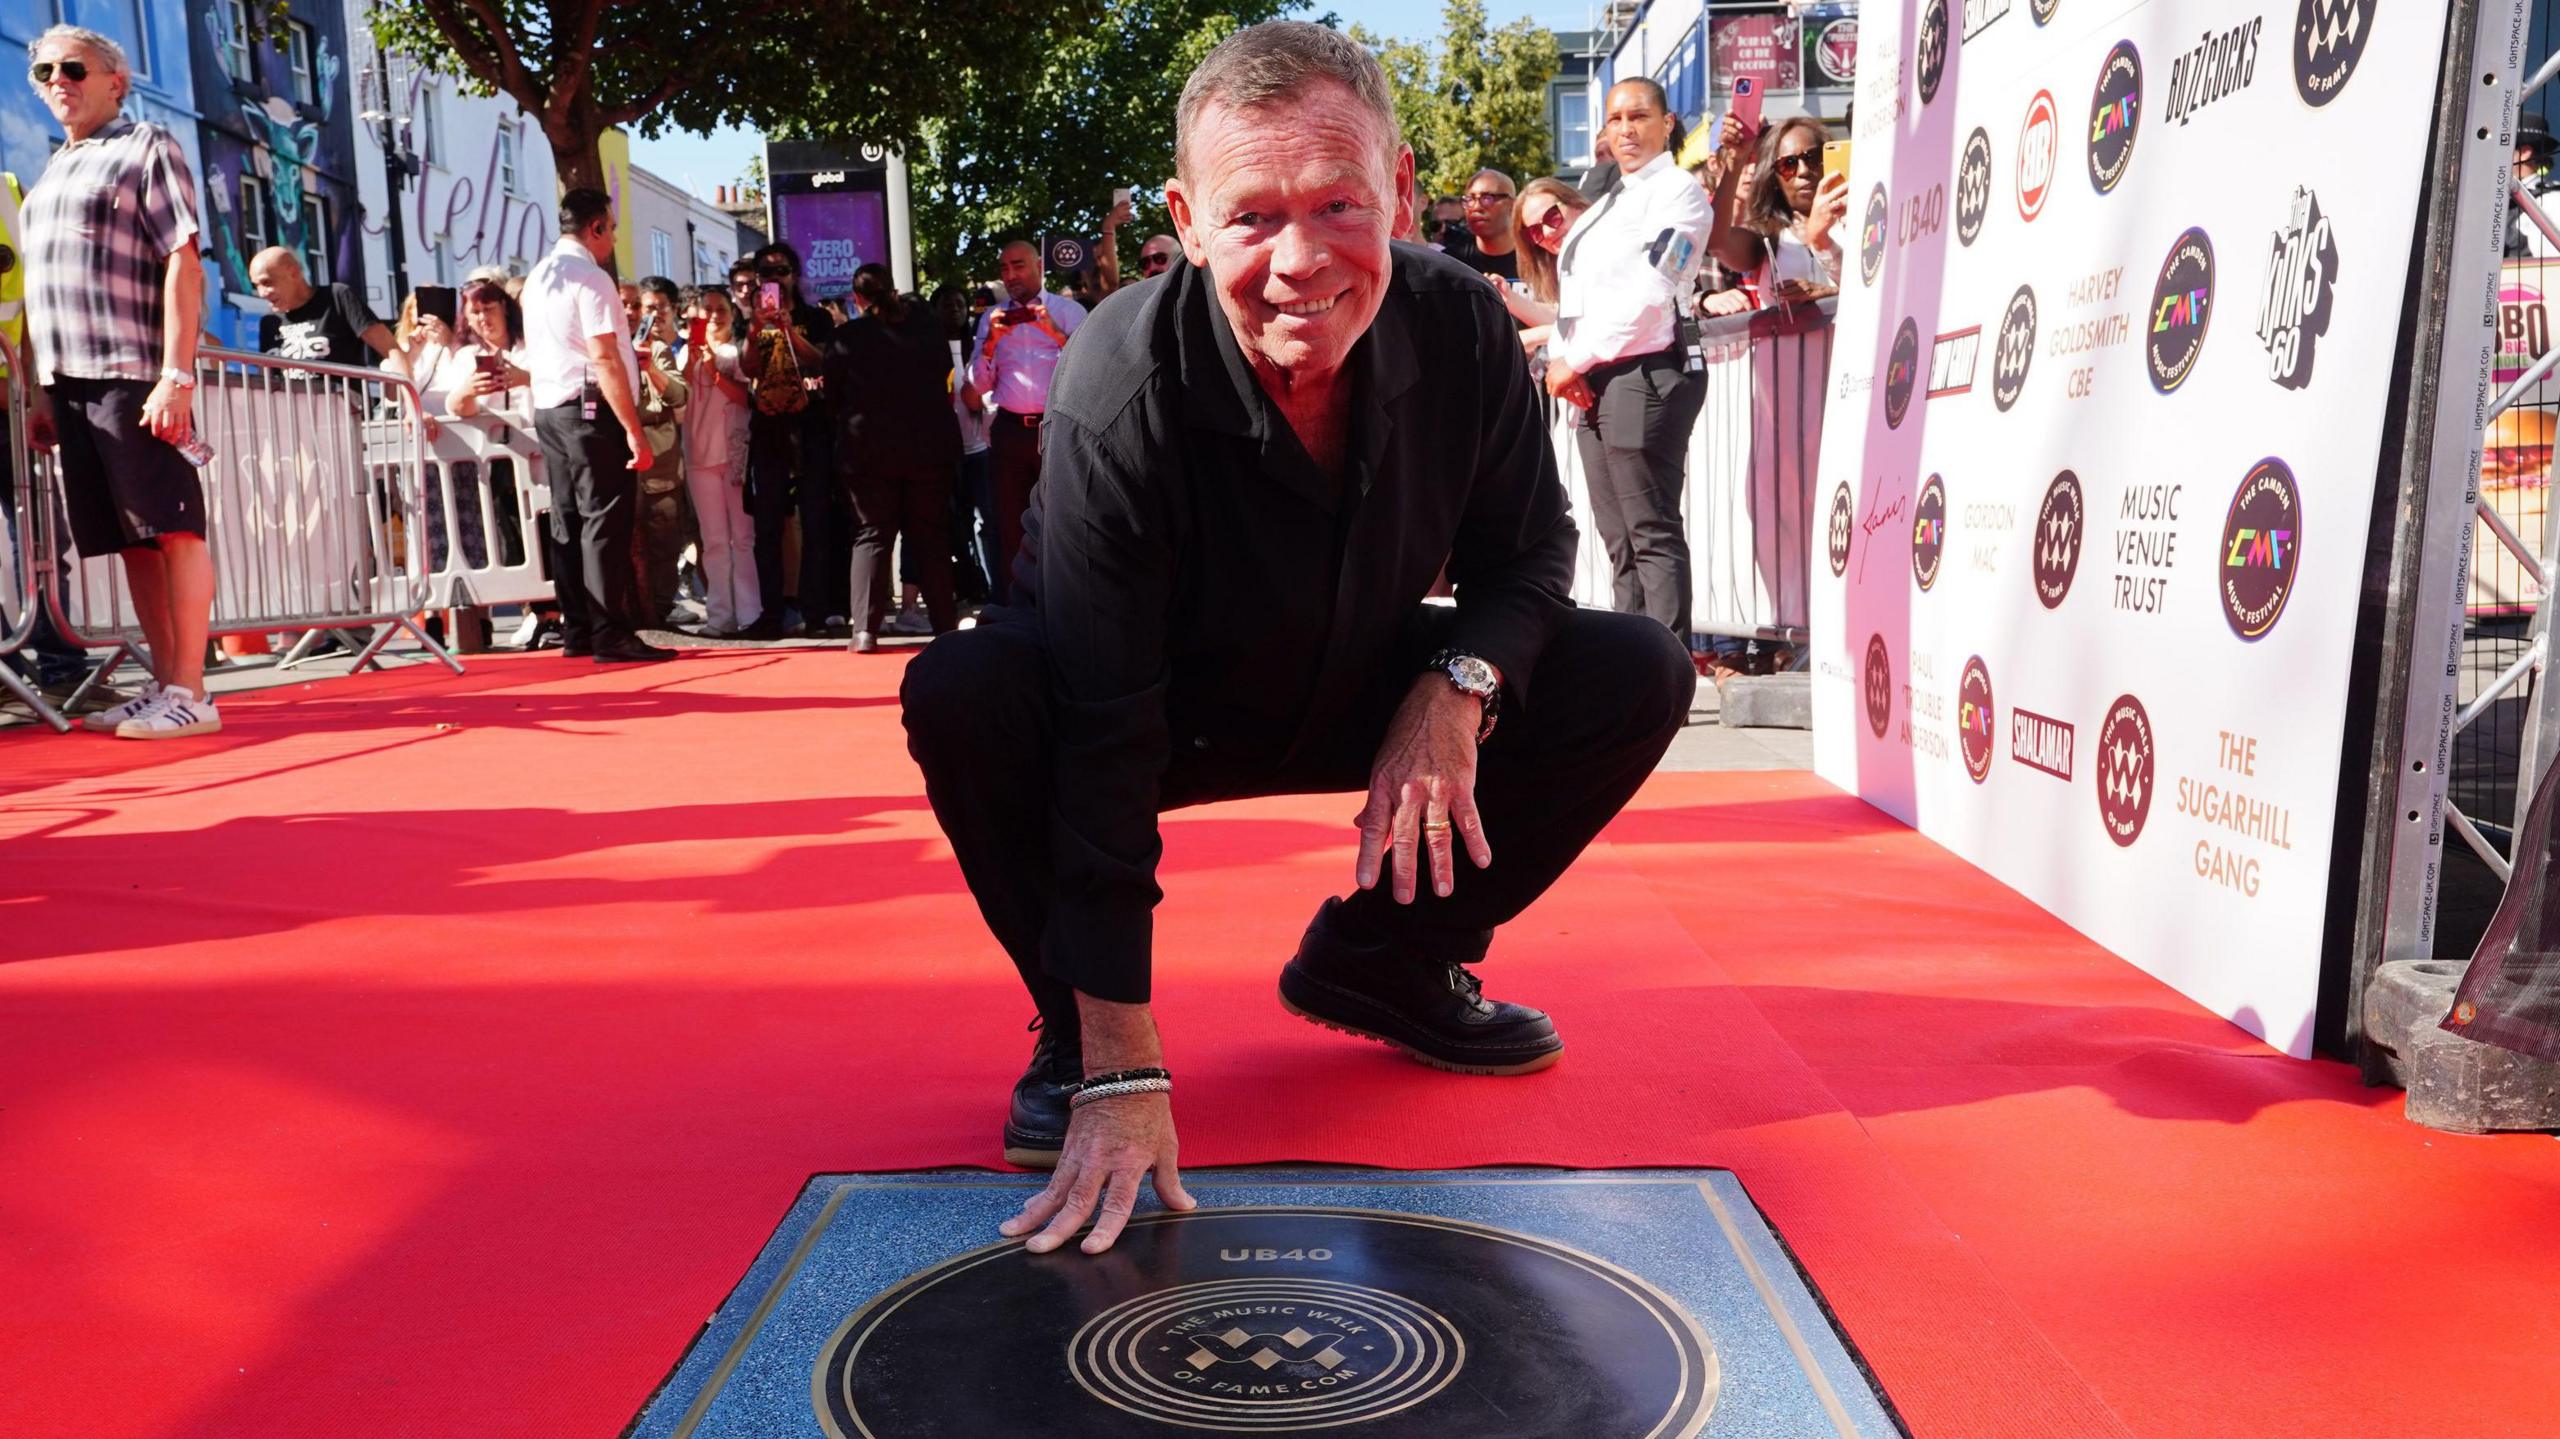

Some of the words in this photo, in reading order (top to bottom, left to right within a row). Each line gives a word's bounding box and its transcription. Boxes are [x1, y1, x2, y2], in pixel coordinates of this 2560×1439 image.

[2100, 68, 2112, 92] THE
[2112, 56, 2135, 78] CAMDEN
[2165, 15, 2262, 126] BUZZCOCKS
[2308, 74, 2320, 91] OF
[2321, 60, 2348, 92] FAME
[2092, 92, 2137, 142] CMF
[811, 170, 845, 188] global
[2092, 152, 2105, 180] MUSIC
[2105, 139, 2130, 181] FESTIVAL
[1898, 183, 1943, 247] UB40
[2491, 165, 2506, 252] LIGHTSPACE-UK.COM
[811, 240, 854, 258] ZERO
[2166, 255, 2180, 280] THE
[2181, 245, 2207, 271] CAMDEN
[2068, 266, 2124, 309] HARVEY
[2153, 288, 2207, 333] CMF
[2050, 313, 2129, 357] GOLDSMITH
[2269, 325, 2300, 380] 60
[2505, 341, 2527, 353] BIG
[2152, 344, 2167, 378] MUSIC
[2166, 338, 2198, 379] FESTIVAL
[2068, 367, 2094, 399] CBE
[2474, 345, 2490, 431] LIGHTSPACE-UK.COM
[2042, 496, 2052, 520] THE
[2053, 481, 2071, 498] MUSIC
[2121, 484, 2182, 521] MUSIC
[2240, 484, 2256, 510] THE
[2258, 477, 2290, 510] CAMDEN
[1964, 503, 2017, 530] GORDON
[1972, 544, 1998, 573] MAC
[2117, 530, 2177, 568] VENUE
[2226, 528, 2291, 569] CMF
[2455, 522, 2471, 605] LIGHTSPACE-UK.COM
[2115, 574, 2167, 614] TRUST
[2226, 579, 2246, 623] MUSIC
[2246, 585, 2283, 625] FESTIVAL
[1900, 719, 1949, 762] ANDERSON
[2014, 713, 2072, 776] SHALAMAR
[2104, 719, 2115, 745] THE
[2115, 706, 2136, 723] MUSIC
[2136, 715, 2150, 757] WALK
[2437, 694, 2452, 776] LIGHTSPACE-UK.COM
[2219, 730, 2257, 777] THE
[2108, 811, 2117, 828] OF
[2117, 819, 2135, 836] FAME
[2177, 776, 2291, 850] SUGARHILL
[2195, 839, 2260, 898] GANG
[2421, 862, 2436, 943] LIGHTSPACE-UK.COM
[1219, 1248, 1333, 1262] UB40
[1166, 1315, 1206, 1336] THE
[1212, 1306, 1296, 1319] MUSIC
[1307, 1309, 1368, 1335] WALK
[1174, 1370, 1206, 1384] OF
